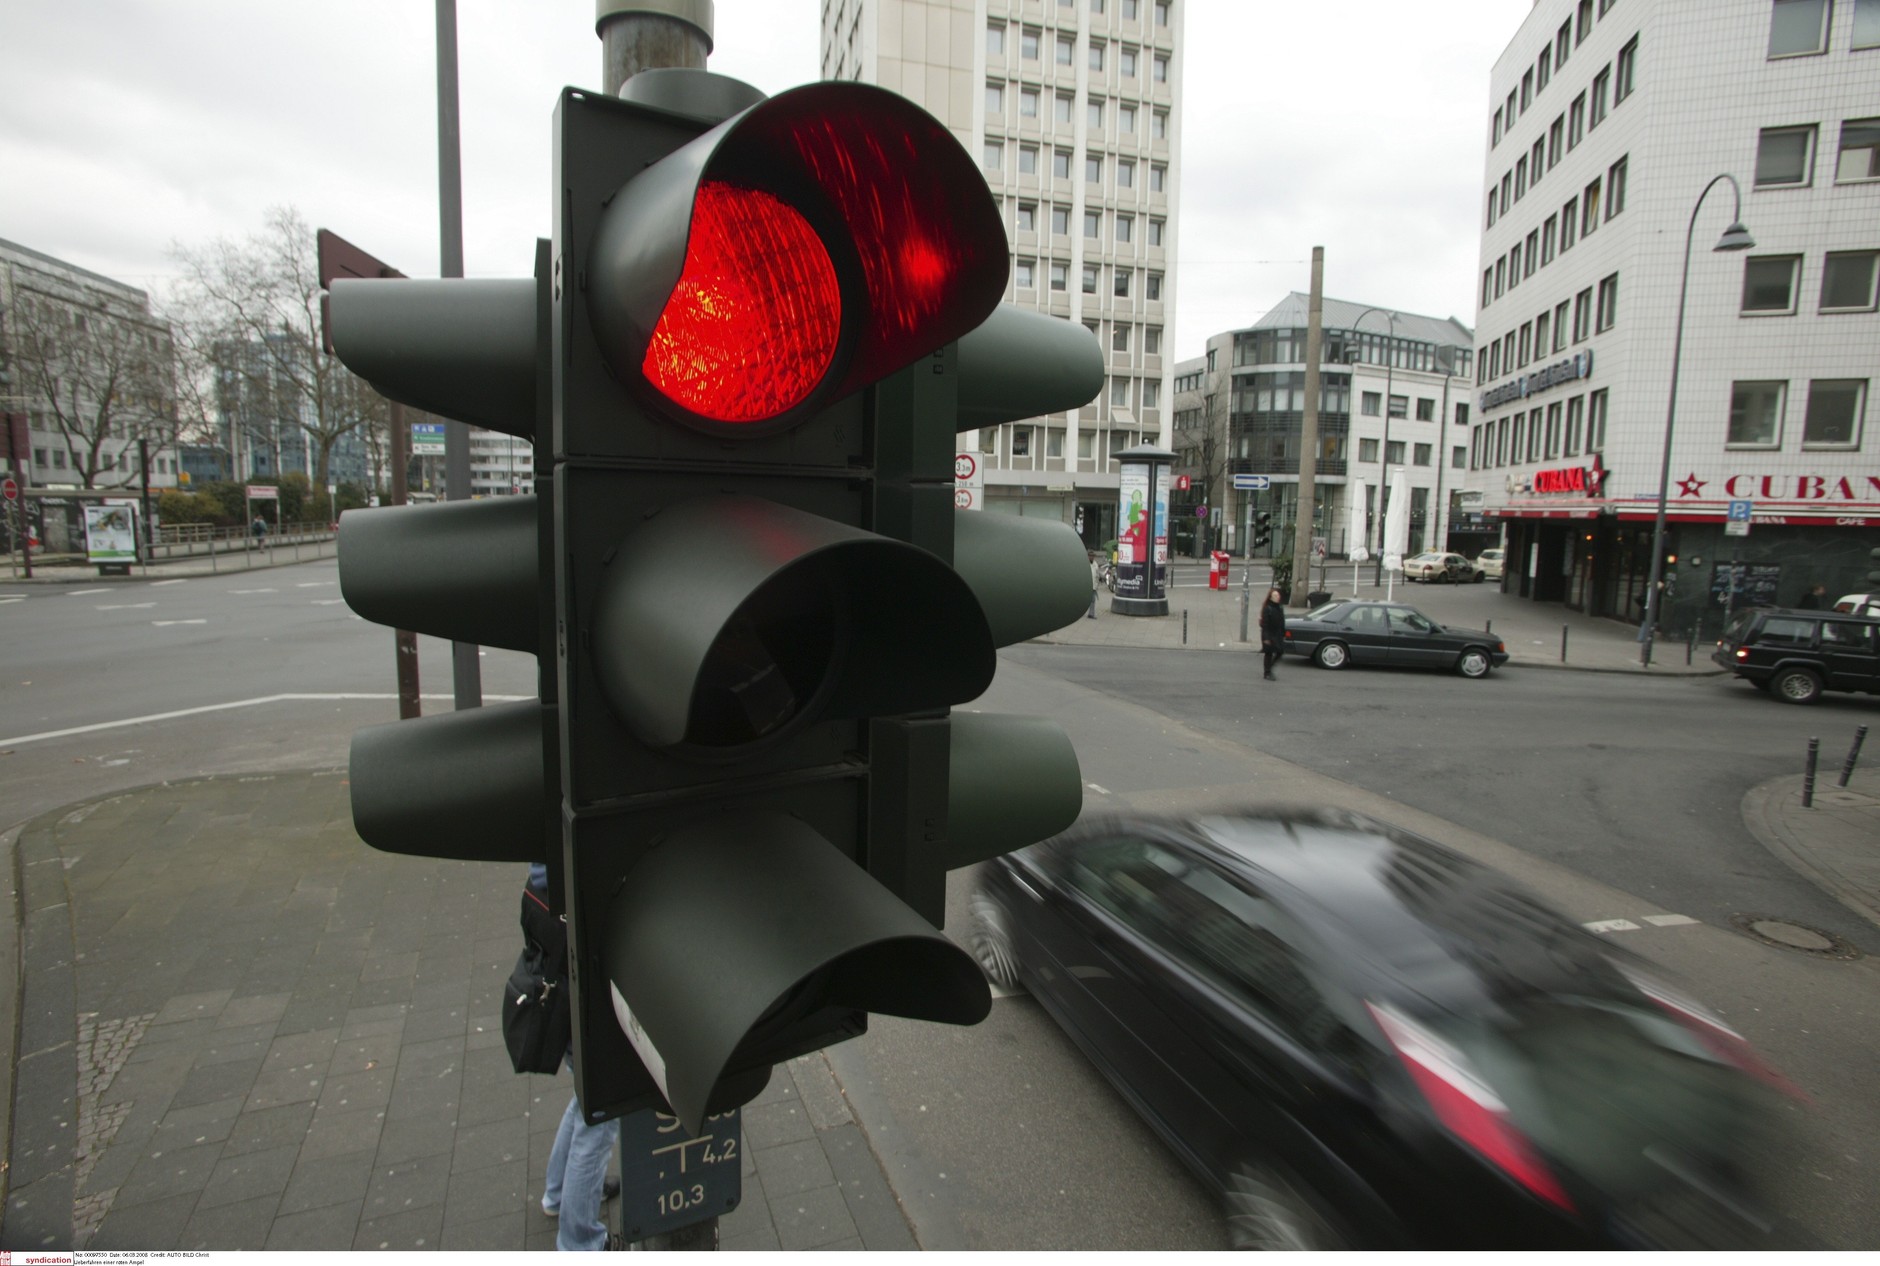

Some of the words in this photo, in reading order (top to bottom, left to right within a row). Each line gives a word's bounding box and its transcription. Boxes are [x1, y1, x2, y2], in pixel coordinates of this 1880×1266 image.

[1534, 466, 1586, 493] CUBANA
[1733, 502, 1748, 518] P
[702, 1138, 737, 1164] 4,2
[657, 1184, 704, 1215] 10,3
